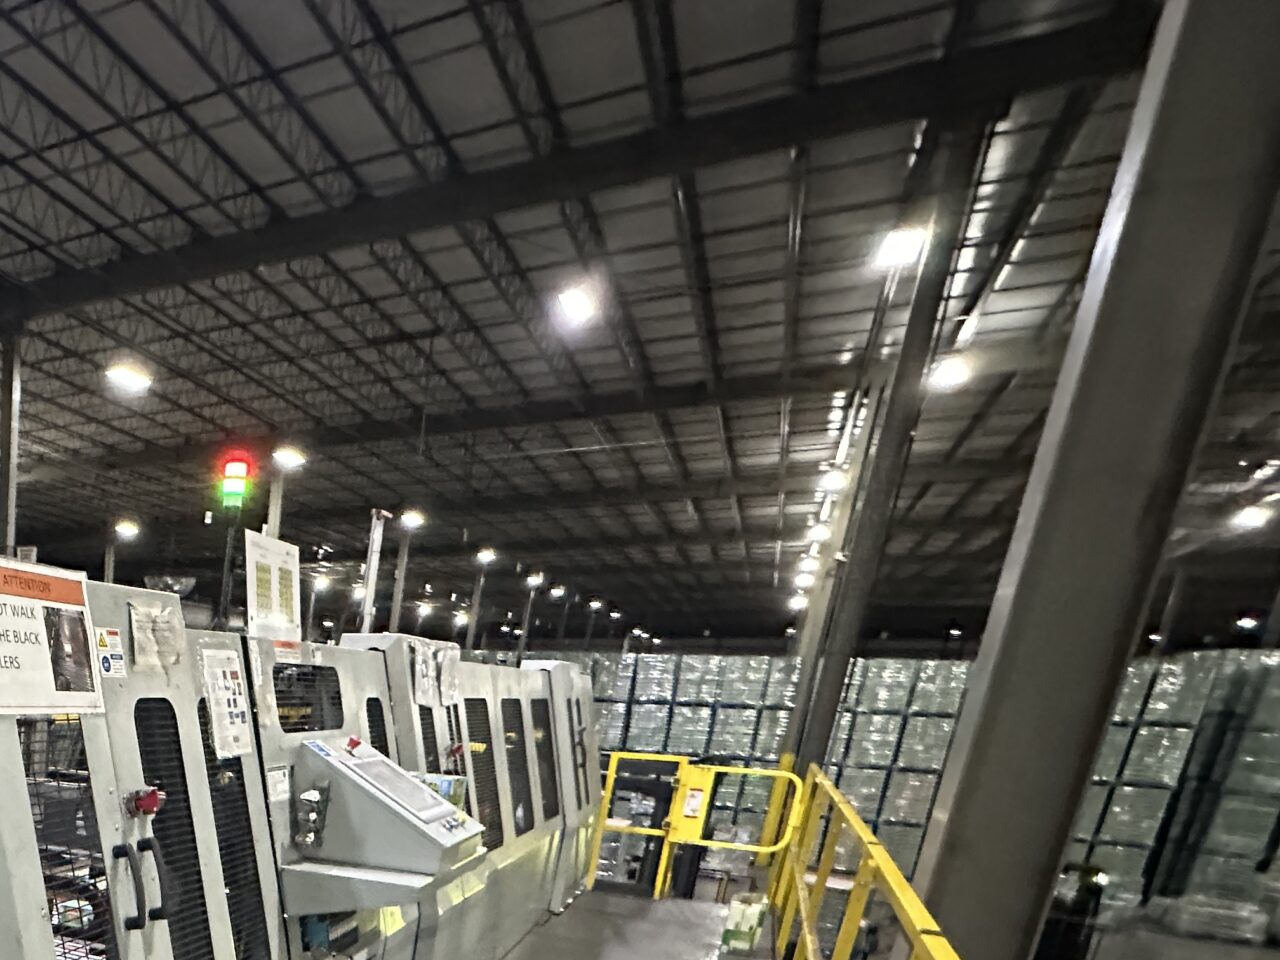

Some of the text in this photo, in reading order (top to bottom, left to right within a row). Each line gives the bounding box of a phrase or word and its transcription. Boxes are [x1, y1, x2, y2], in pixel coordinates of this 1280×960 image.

[2, 574, 51, 593] ATTENTION
[10, 603, 37, 619] WALK
[13, 630, 41, 645] BLACK
